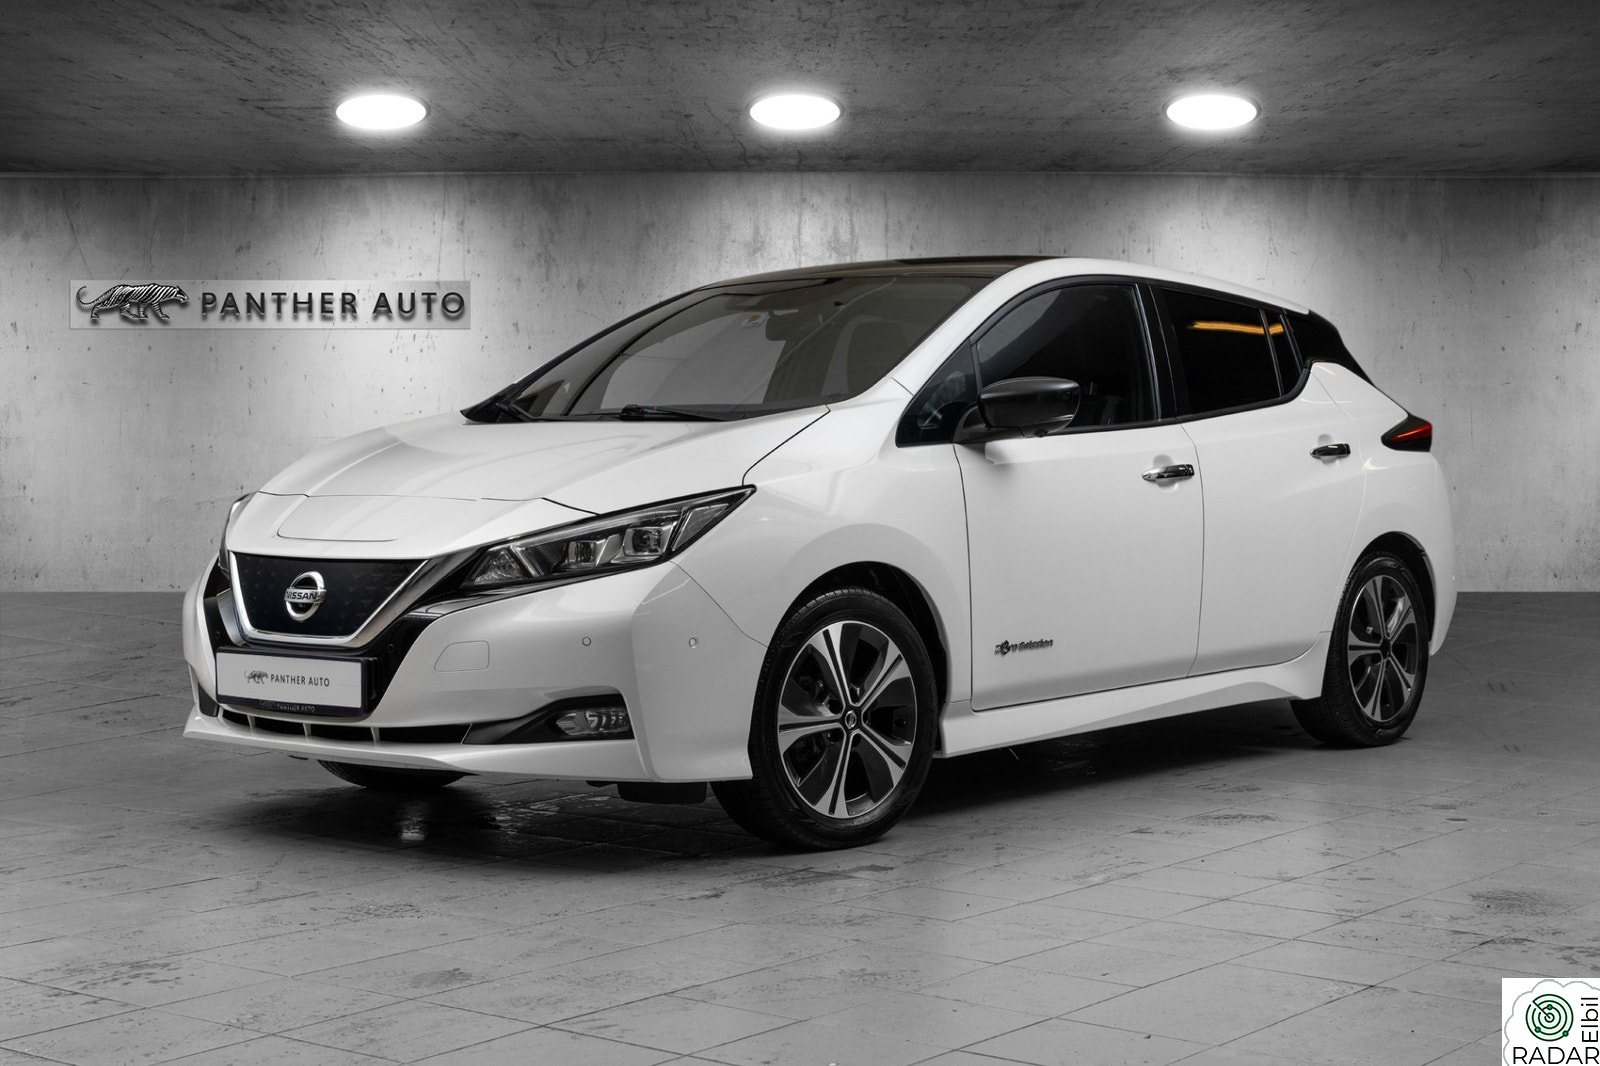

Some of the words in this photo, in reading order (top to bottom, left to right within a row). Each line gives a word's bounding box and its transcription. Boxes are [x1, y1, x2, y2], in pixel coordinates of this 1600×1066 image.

[201, 291, 358, 316] PANTHER
[372, 291, 465, 316] AUTO
[286, 590, 318, 600] NISSAN
[270, 673, 306, 686] PANTHER
[308, 676, 330, 688] AUTO
